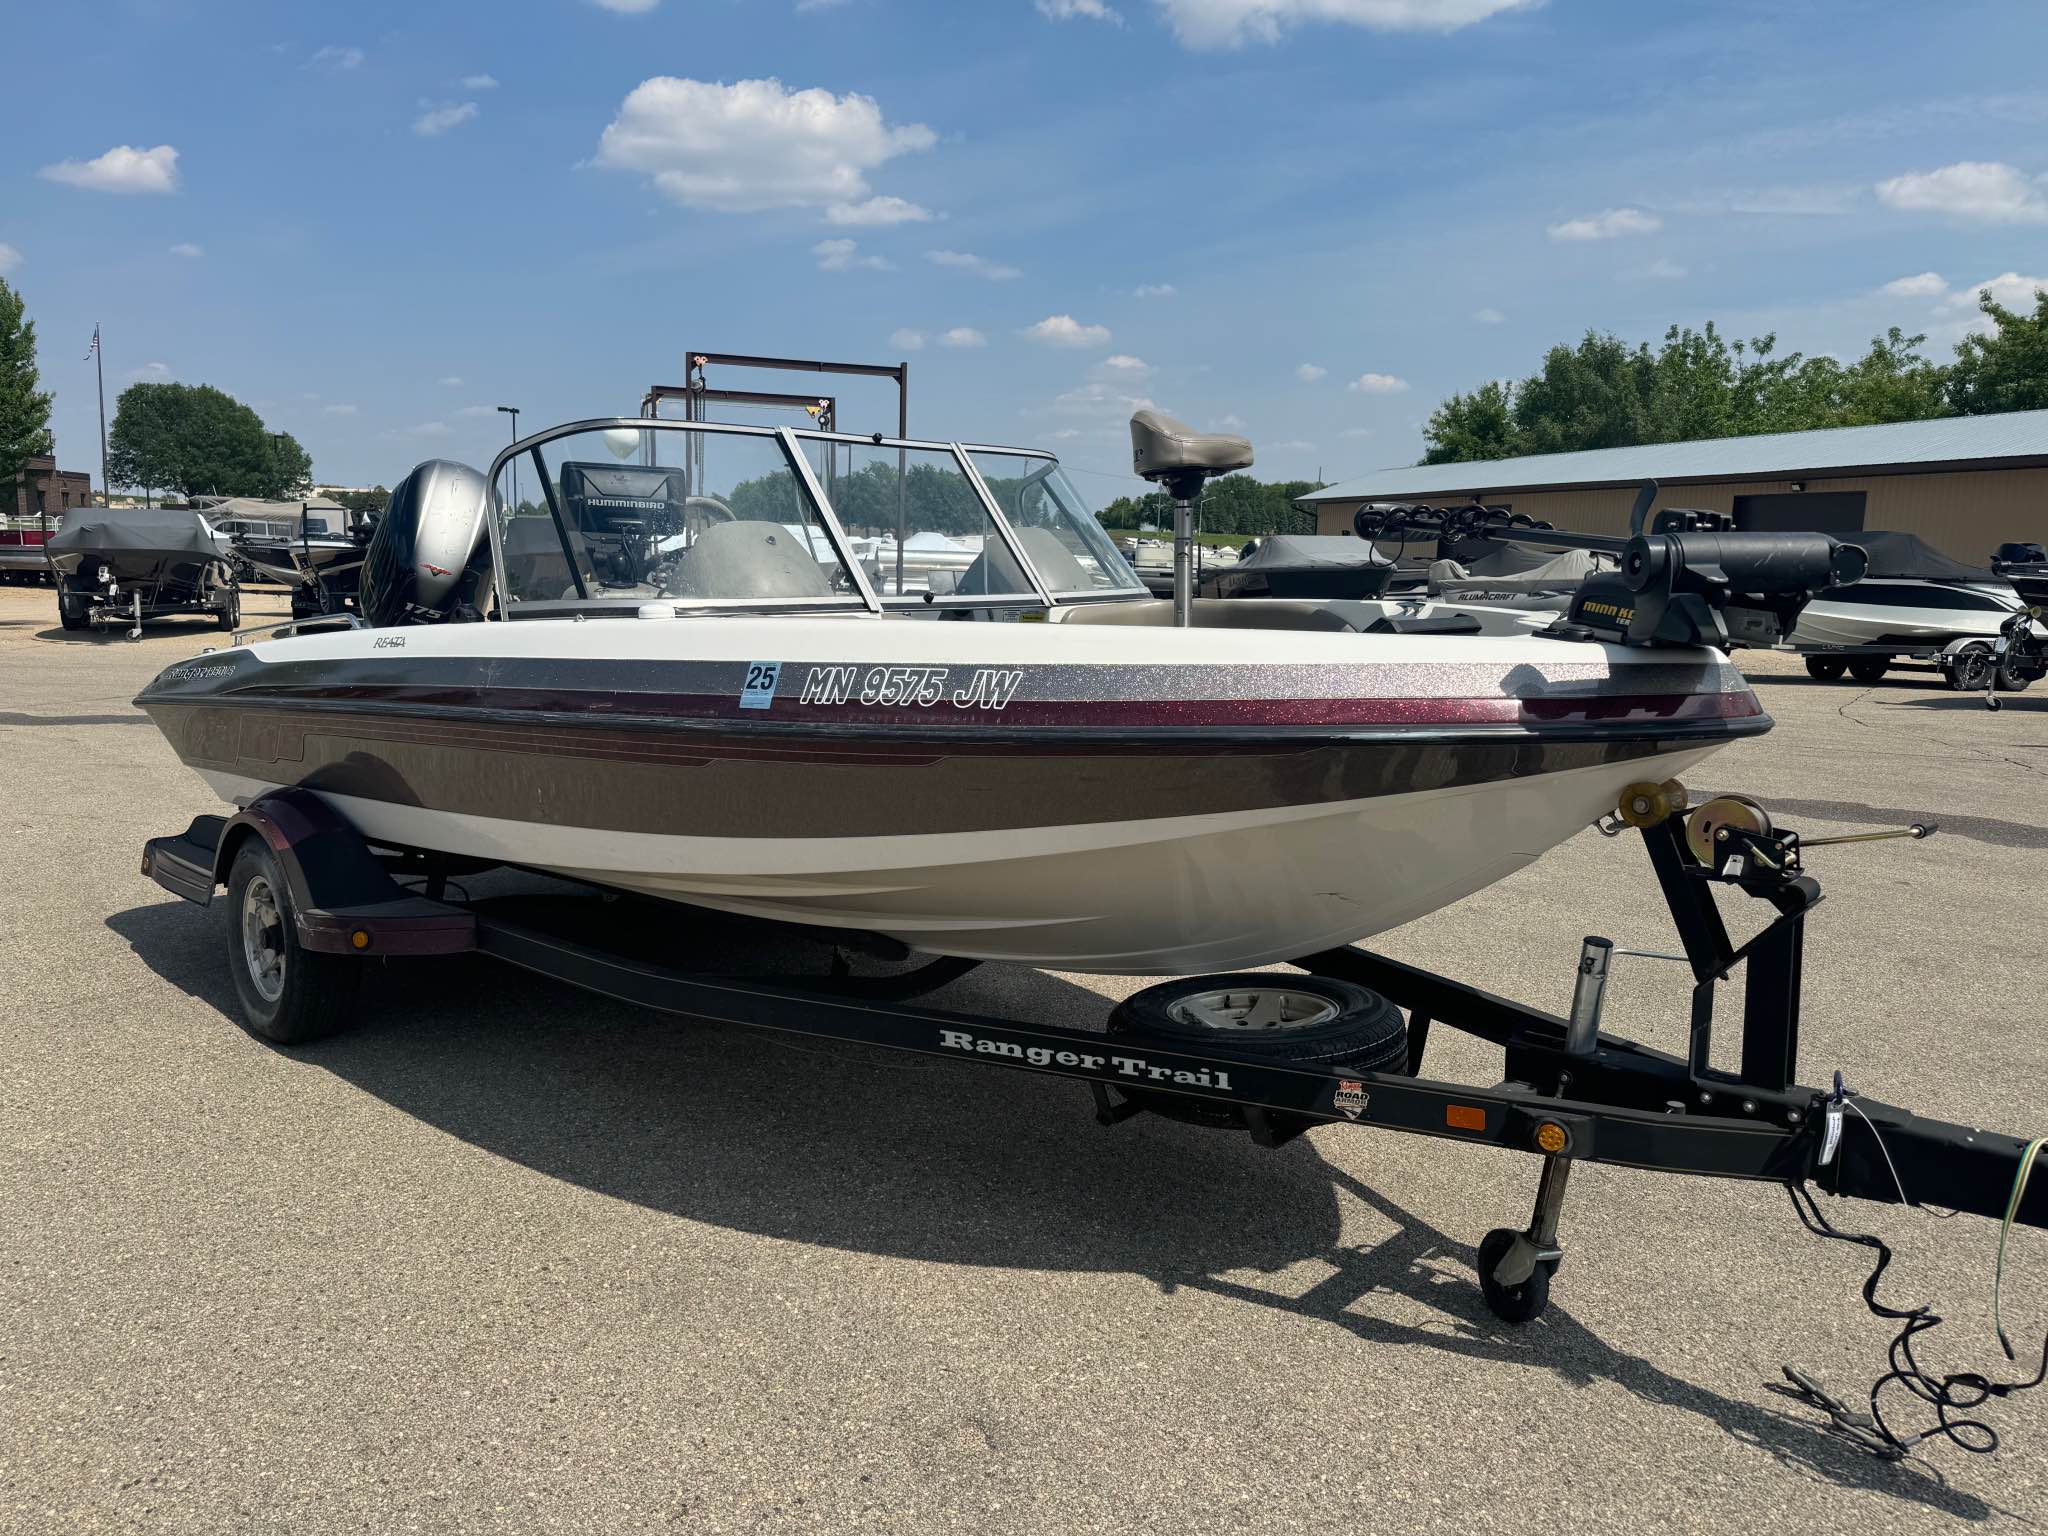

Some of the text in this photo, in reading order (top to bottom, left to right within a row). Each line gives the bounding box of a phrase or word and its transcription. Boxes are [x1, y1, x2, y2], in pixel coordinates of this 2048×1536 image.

[587, 498, 665, 510] HUMMINBIRD
[1458, 593, 1518, 601] ALUMACRAFT
[405, 602, 441, 619] 175
[373, 636, 406, 649] REATA
[746, 666, 777, 690] 25
[800, 667, 1023, 709] MN 9575 JW
[940, 1029, 1233, 1090] Ranger Trail
[1335, 1097, 1367, 1106] ARMOR
[1336, 1091, 1369, 1100] ROAD
